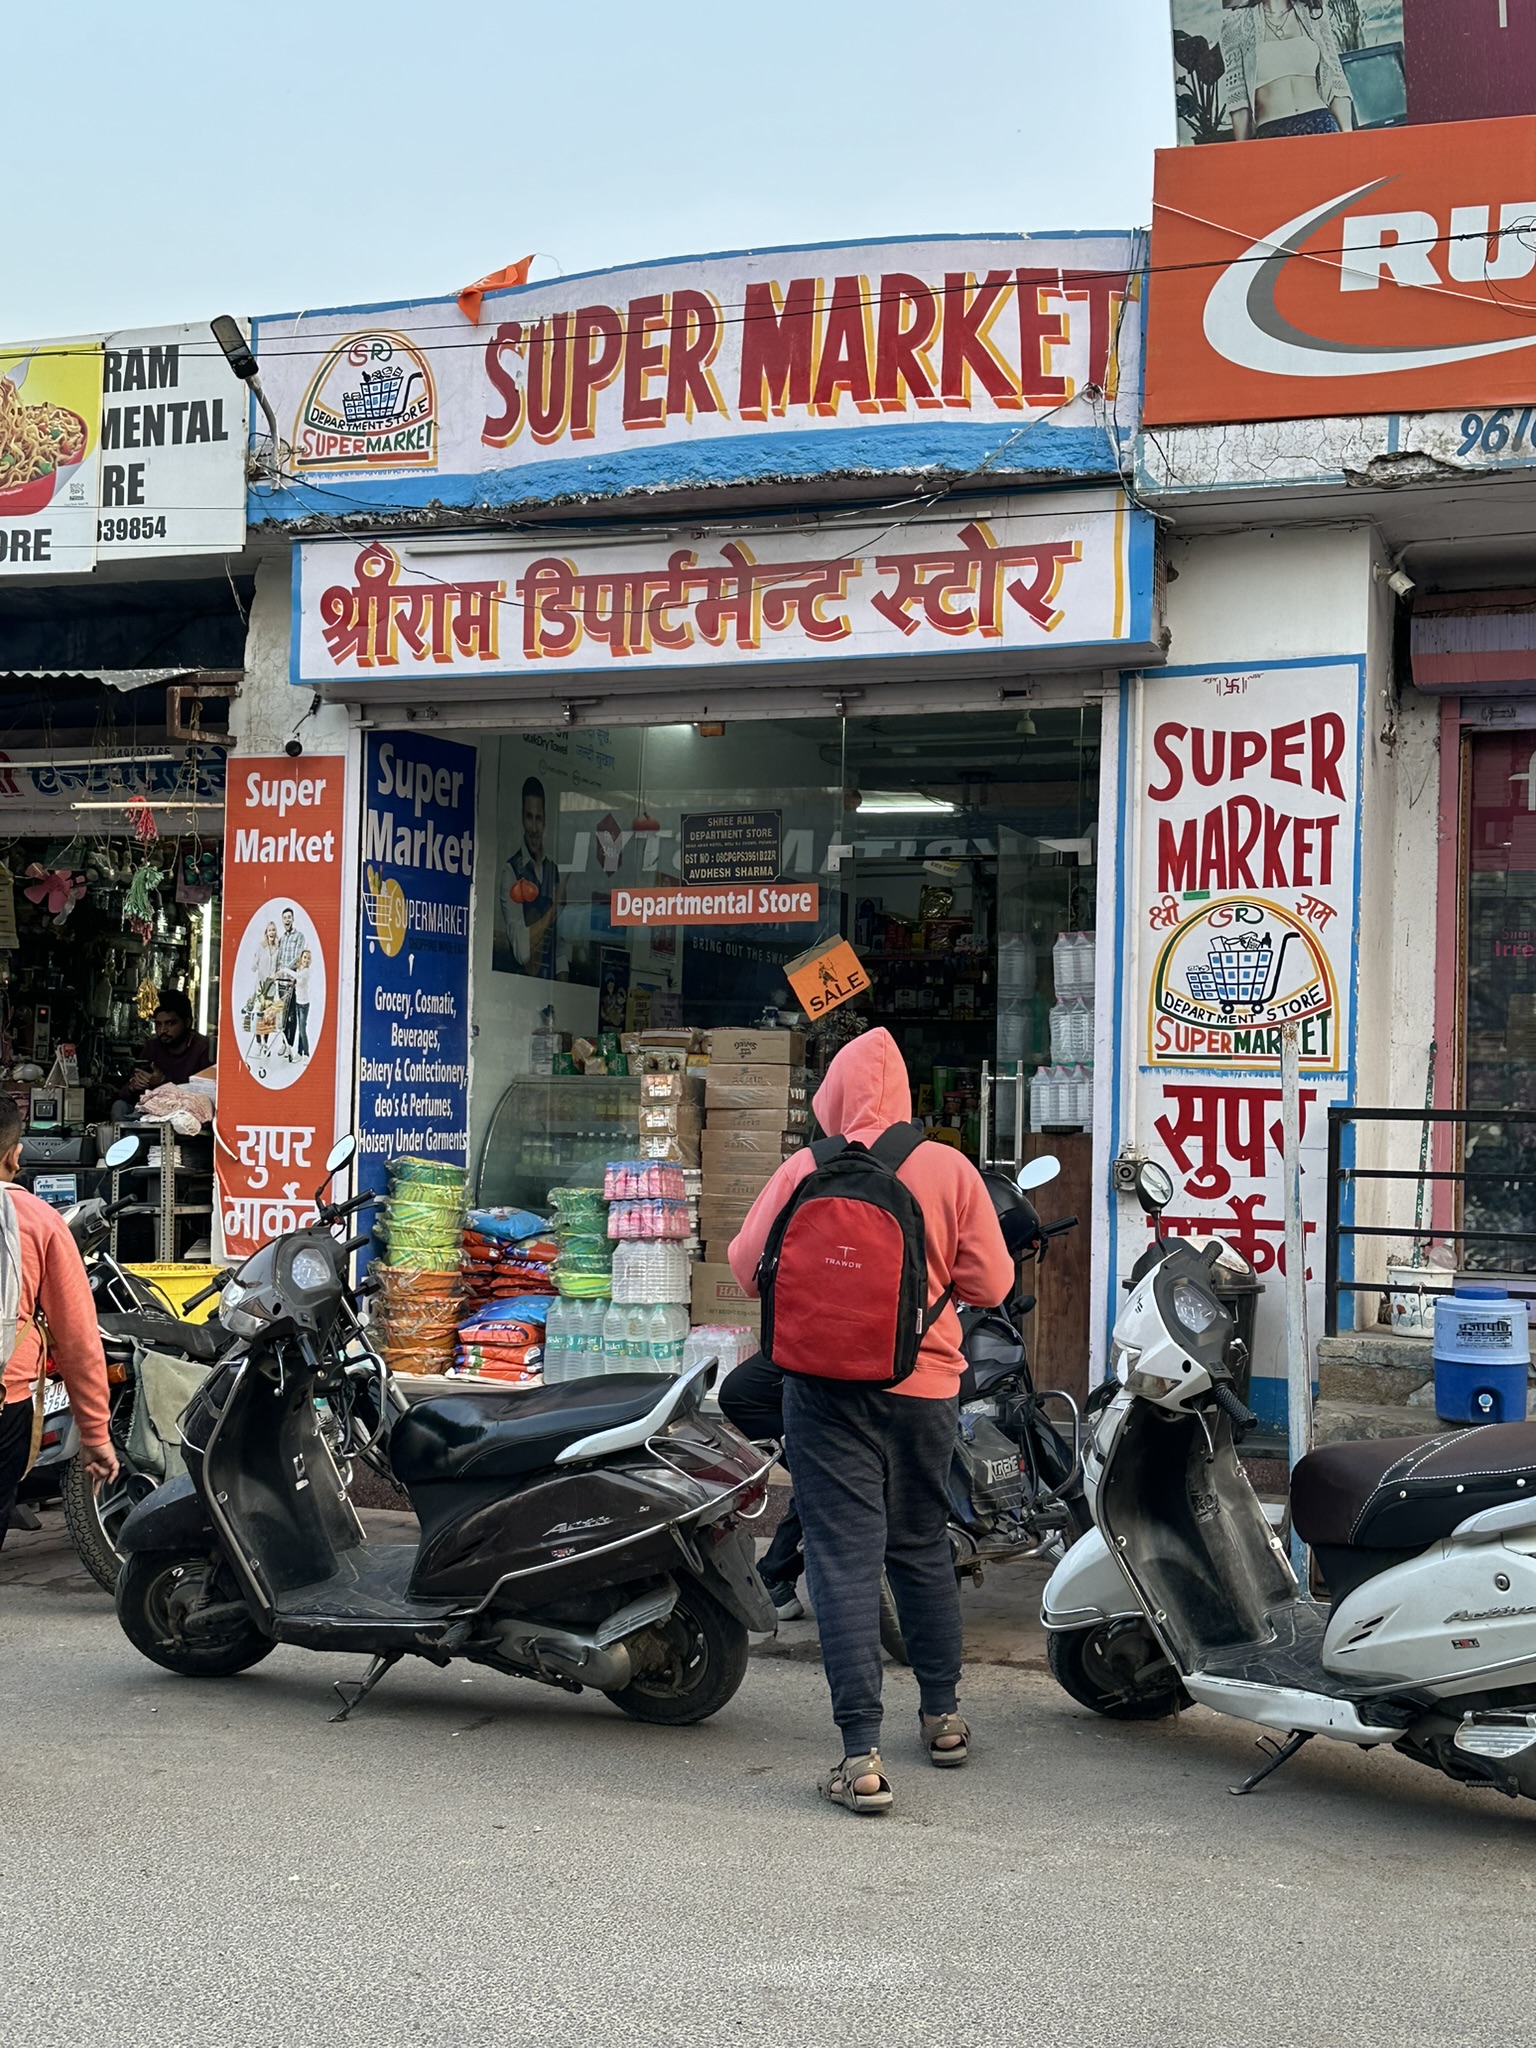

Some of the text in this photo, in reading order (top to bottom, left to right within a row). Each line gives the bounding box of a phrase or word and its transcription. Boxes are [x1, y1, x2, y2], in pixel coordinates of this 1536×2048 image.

[1340, 202, 1536, 292] RU
[481, 266, 1140, 449] SUPER MARKET
[310, 397, 429, 432] DEPARTMENT STORE
[320, 540, 507, 668] श्रीराम
[871, 522, 1083, 638] स्टोर
[1148, 711, 1347, 802] SUPER
[246, 772, 326, 817] Super
[378, 742, 464, 818] Super
[690, 828, 772, 841] DEPARTMENT STORE
[708, 815, 755, 827] SHREE RAM
[234, 829, 334, 864] Market
[366, 809, 473, 877] Market
[685, 853, 697, 864] GST
[700, 852, 709, 863] NO
[1158, 795, 1340, 893] MARKET
[689, 866, 774, 879] AVDHESH SHARMA
[395, 898, 469, 936] SUPERMARKET
[616, 887, 811, 924] Departmental Store
[1295, 893, 1338, 933] राम
[692, 936, 722, 954] BRING
[725, 944, 743, 958] OUT
[747, 947, 764, 962] THE
[375, 985, 457, 1020] Grocery, Cosmatic,
[810, 971, 865, 1012] SALE
[1164, 984, 1324, 1024] DEPARTMENT STORE
[391, 1022, 440, 1055] Beverages,
[1155, 1008, 1332, 1055] SUPERMARET
[360, 1057, 467, 1090] Bakery & Confectionery,
[375, 1092, 453, 1120] deo's & Perfumes,
[236, 1125, 316, 1189] सुपर
[358, 1128, 394, 1160] Hoisery
[395, 1128, 425, 1152] Under
